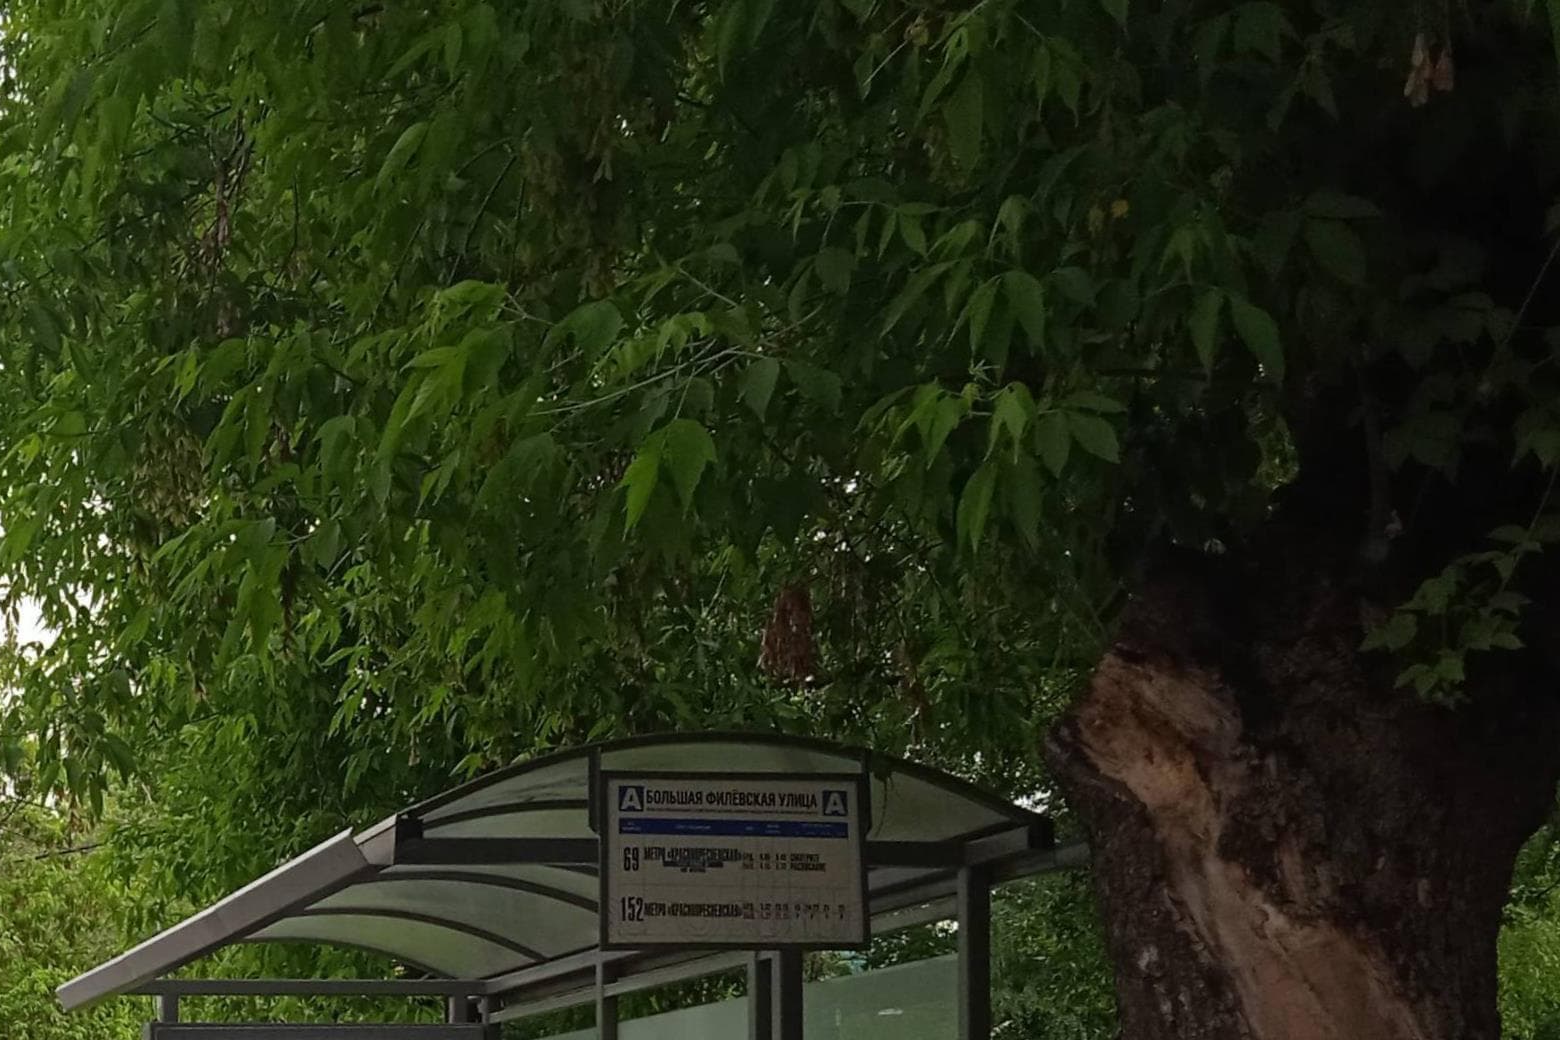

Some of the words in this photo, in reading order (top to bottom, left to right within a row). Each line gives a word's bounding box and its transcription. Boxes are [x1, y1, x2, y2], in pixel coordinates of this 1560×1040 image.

[620, 787, 643, 811] А
[646, 789, 702, 805] БОЛЬШАЯ
[706, 789, 775, 806] ФИЛЁВСКАЯ
[779, 792, 817, 809] УЛИЦА
[824, 792, 847, 815] А
[623, 847, 639, 871] 69
[621, 896, 644, 921] 152
